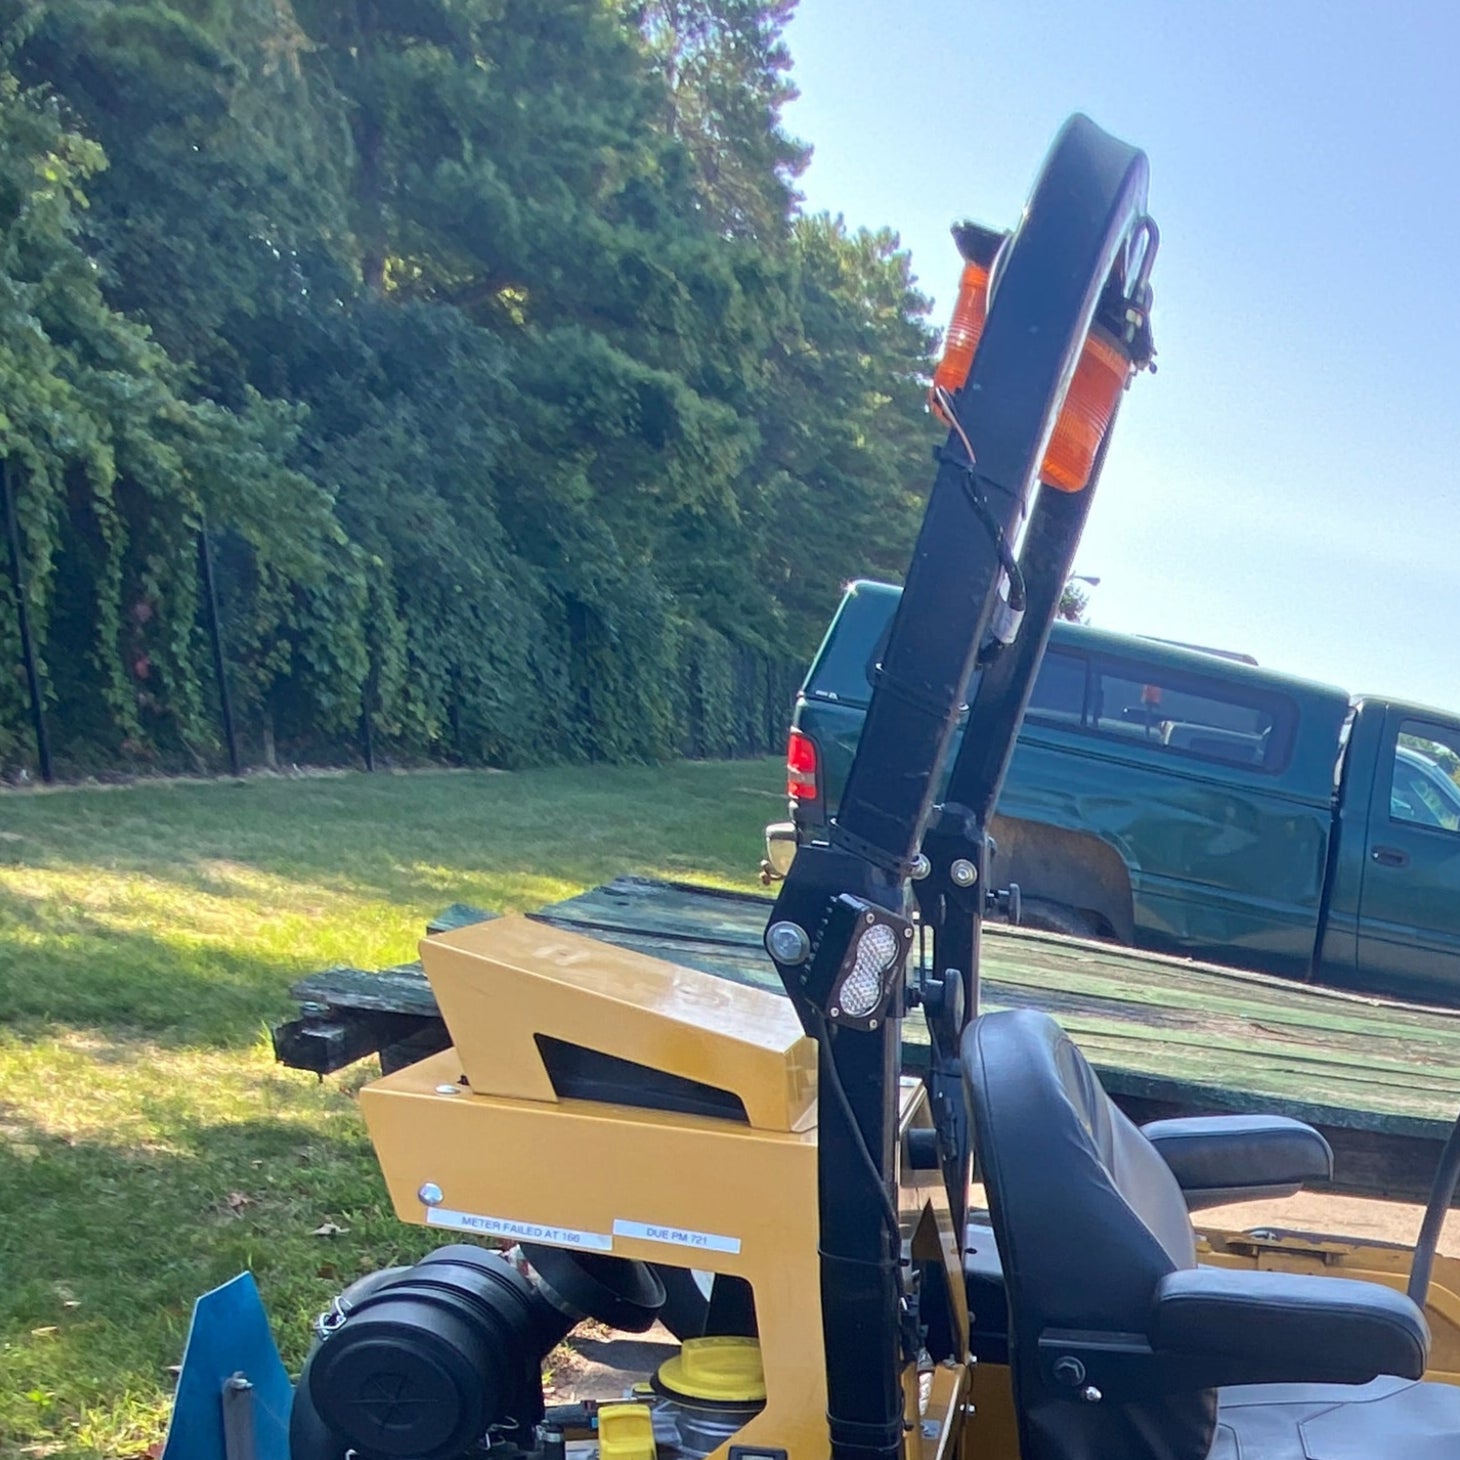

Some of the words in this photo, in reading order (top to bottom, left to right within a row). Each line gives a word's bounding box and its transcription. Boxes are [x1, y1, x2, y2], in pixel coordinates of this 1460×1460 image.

[461, 1216, 501, 1231] METER
[503, 1222, 542, 1237] FAILED
[544, 1231, 559, 1240] AT
[646, 1227, 669, 1240] DUE
[671, 1232, 689, 1243] PM
[690, 1235, 707, 1246] 721
